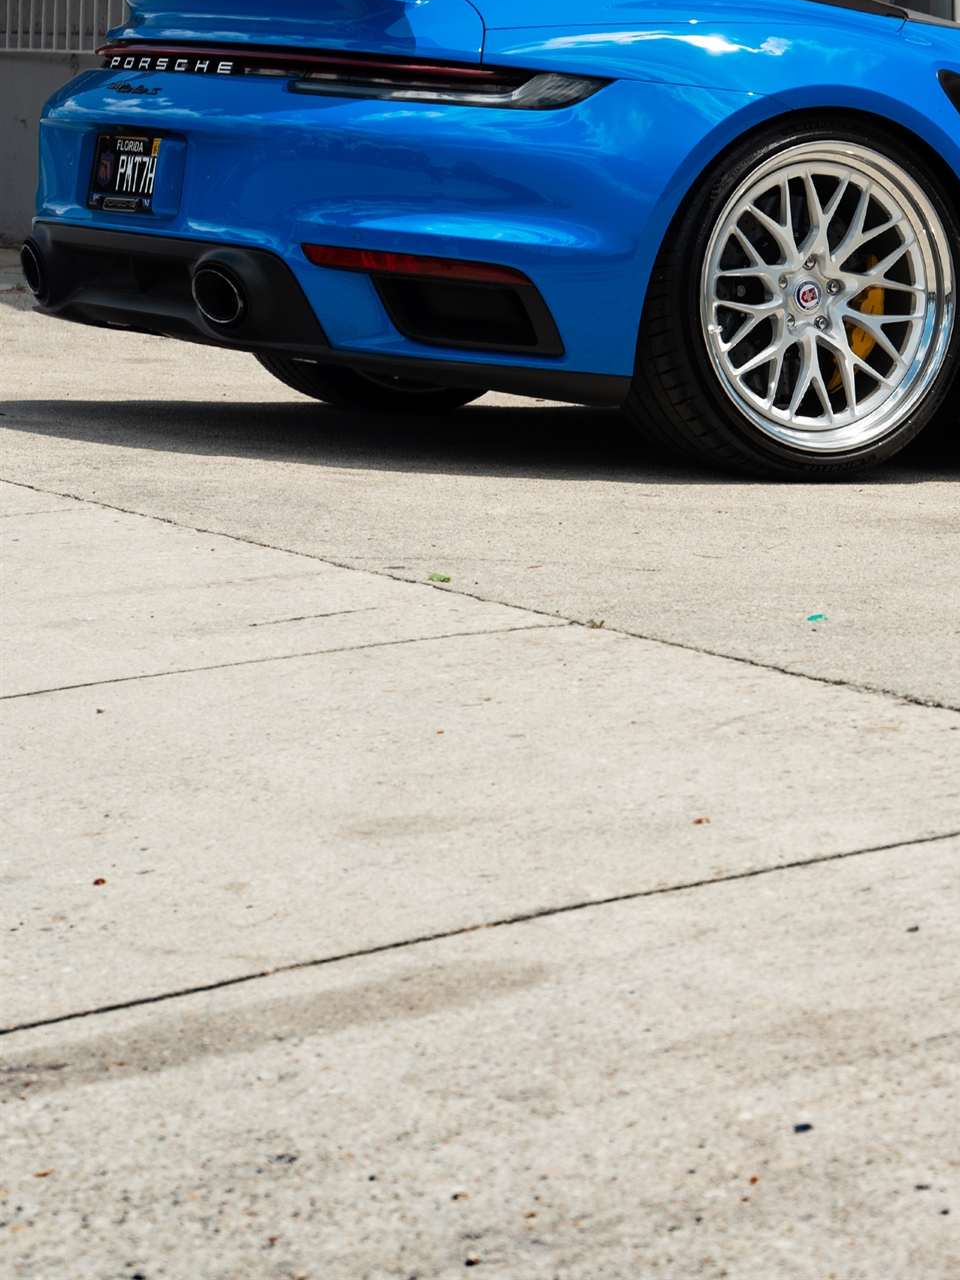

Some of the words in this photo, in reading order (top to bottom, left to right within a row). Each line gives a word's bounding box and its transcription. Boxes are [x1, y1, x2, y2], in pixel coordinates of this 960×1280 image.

[110, 56, 234, 74] PORSCHE
[116, 139, 144, 152] FLORIDA
[803, 460, 862, 472] MICHELIN
